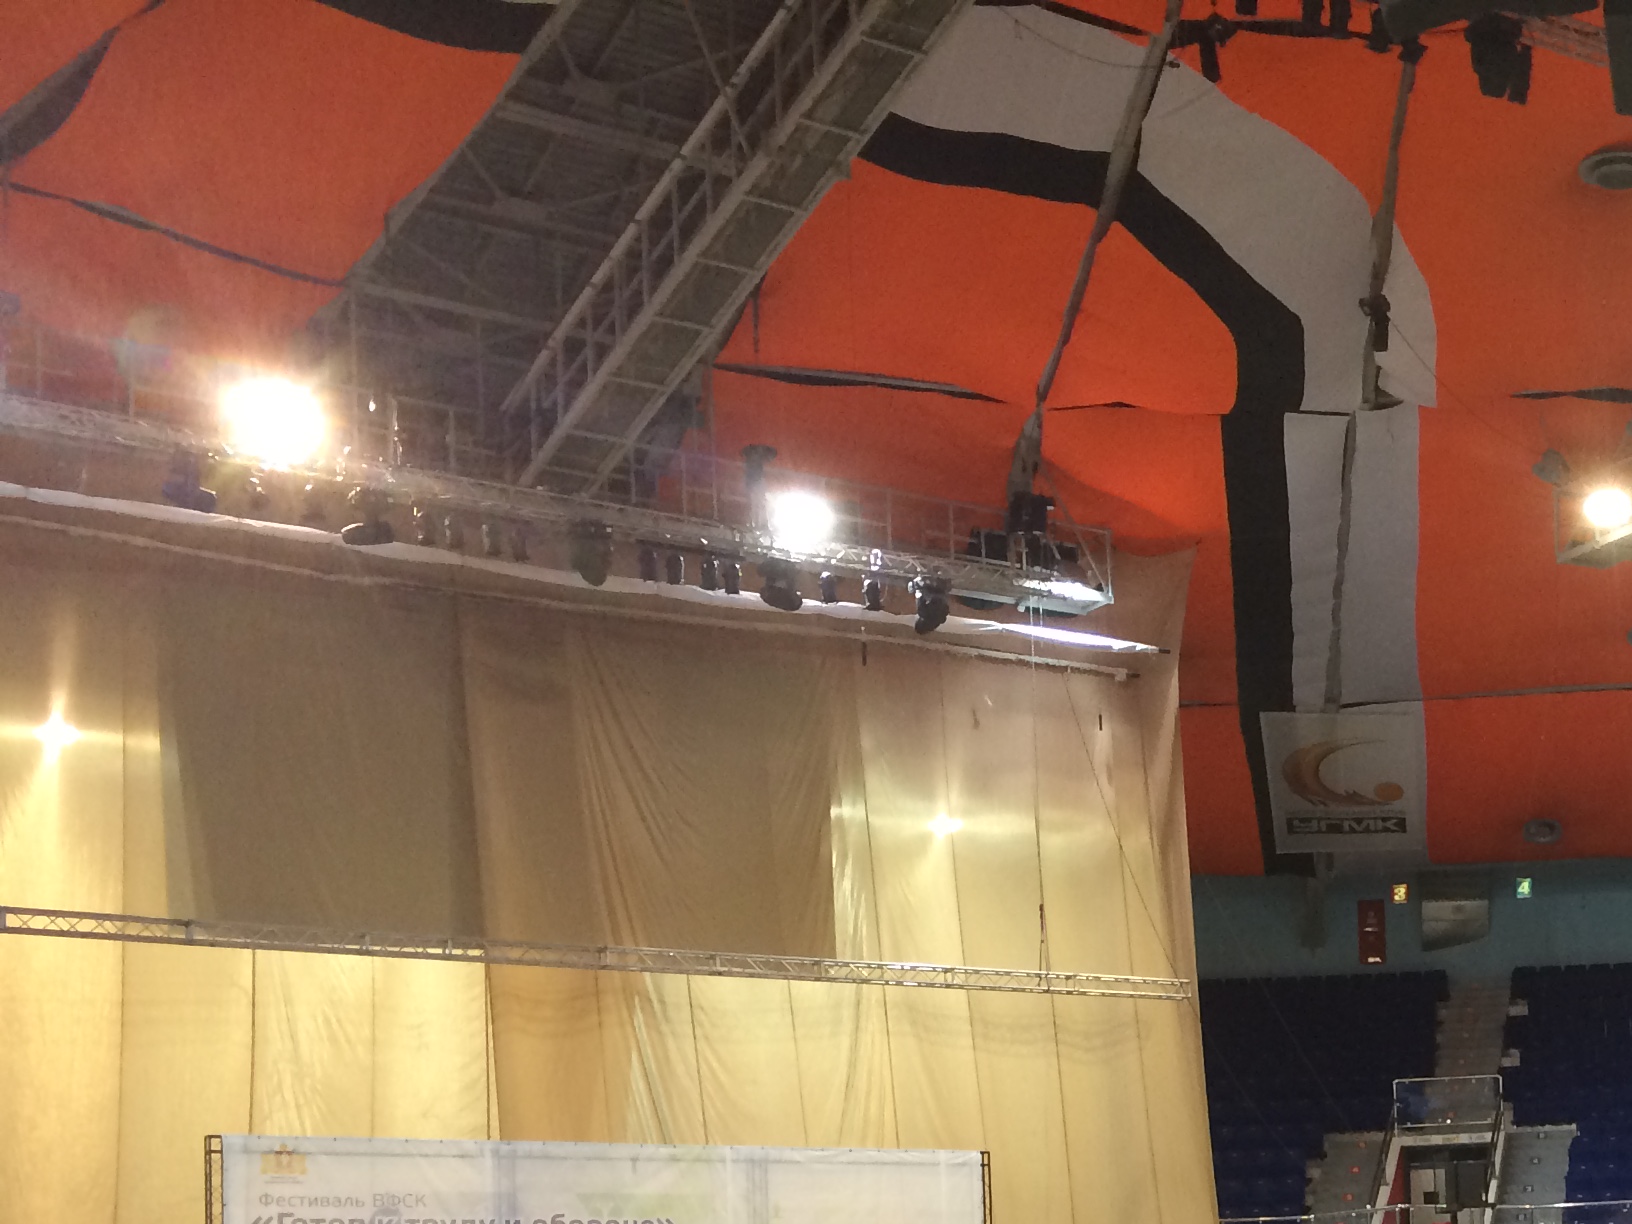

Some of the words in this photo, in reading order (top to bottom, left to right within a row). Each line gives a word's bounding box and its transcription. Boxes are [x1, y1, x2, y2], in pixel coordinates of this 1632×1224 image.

[1292, 818, 1401, 832] УГМК
[1394, 887, 1407, 901] 3
[1517, 880, 1530, 895] 4
[257, 1192, 366, 1209] Фестиваль
[372, 1192, 427, 1209] ВФСК
